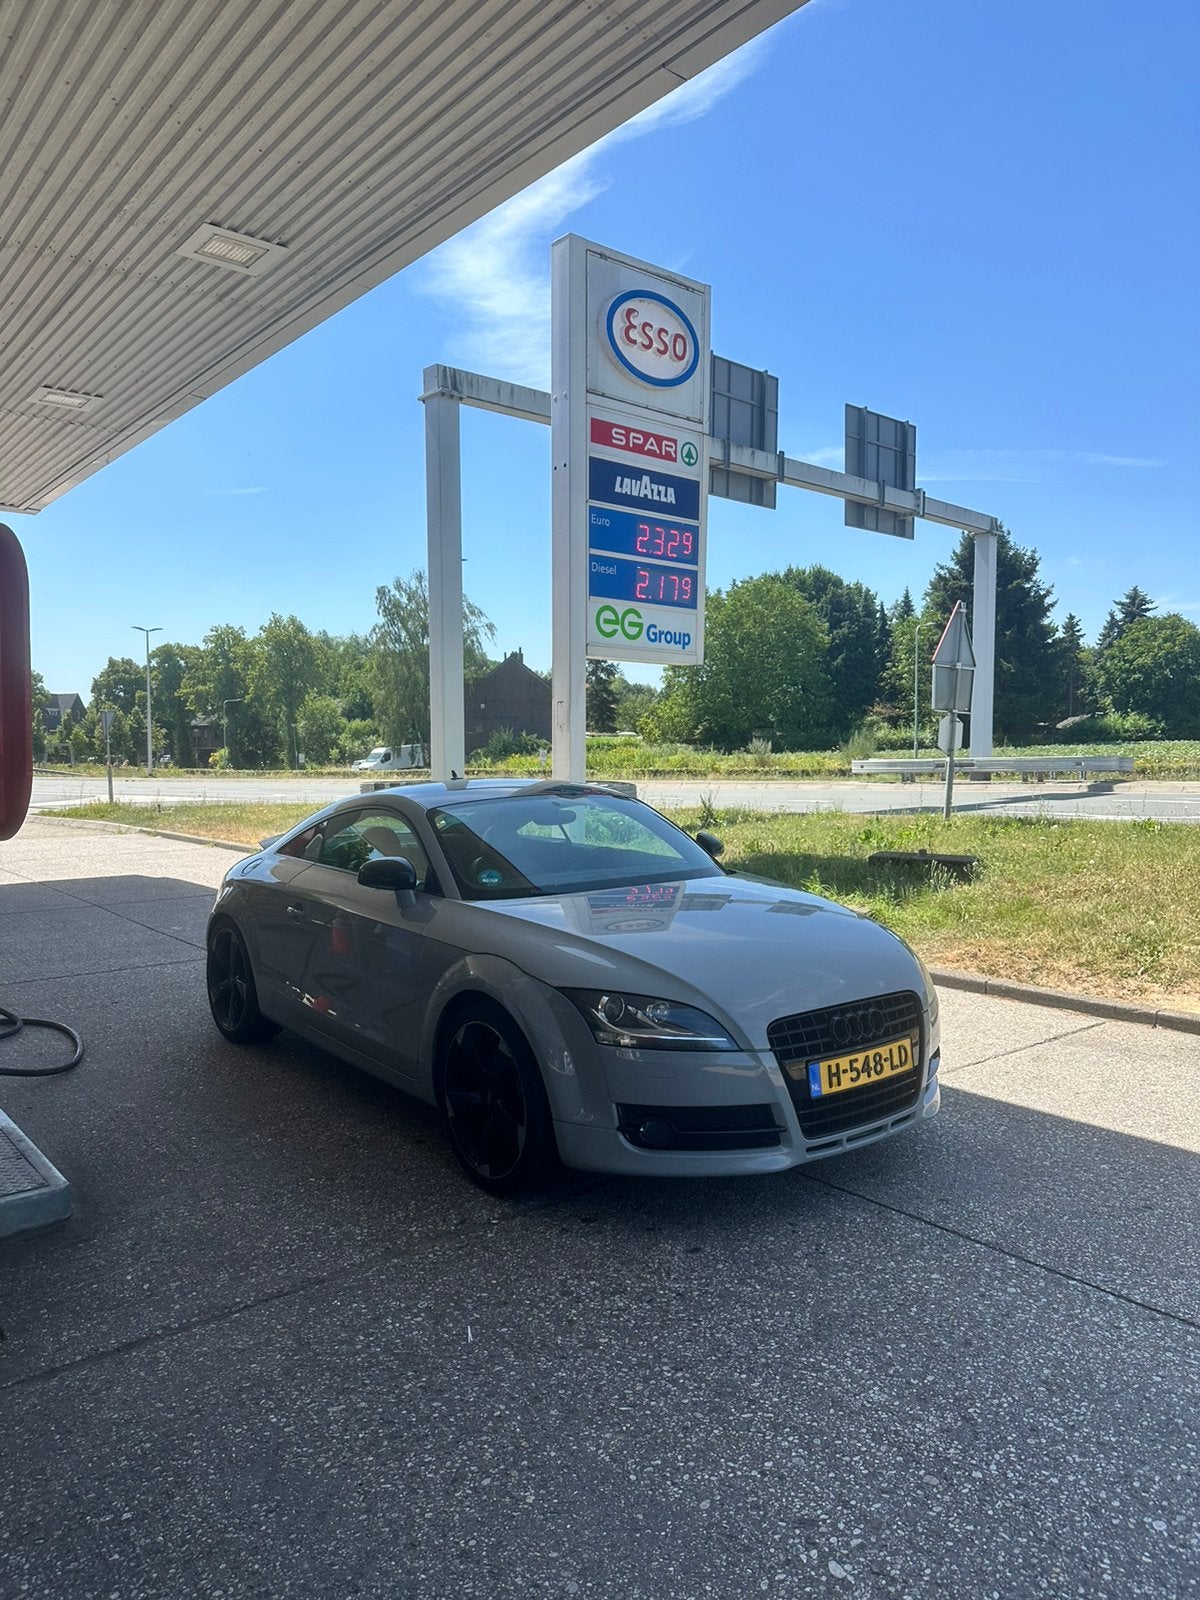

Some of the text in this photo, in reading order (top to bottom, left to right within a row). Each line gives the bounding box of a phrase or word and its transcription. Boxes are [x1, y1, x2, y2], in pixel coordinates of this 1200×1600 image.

[611, 427, 676, 458] SPAR
[614, 474, 676, 505] LAVAZZA
[591, 513, 693, 558] Euro 2.329
[591, 561, 691, 600] Diesel 2.179
[646, 623, 691, 650] Group
[827, 1044, 909, 1089] H-548-LD
